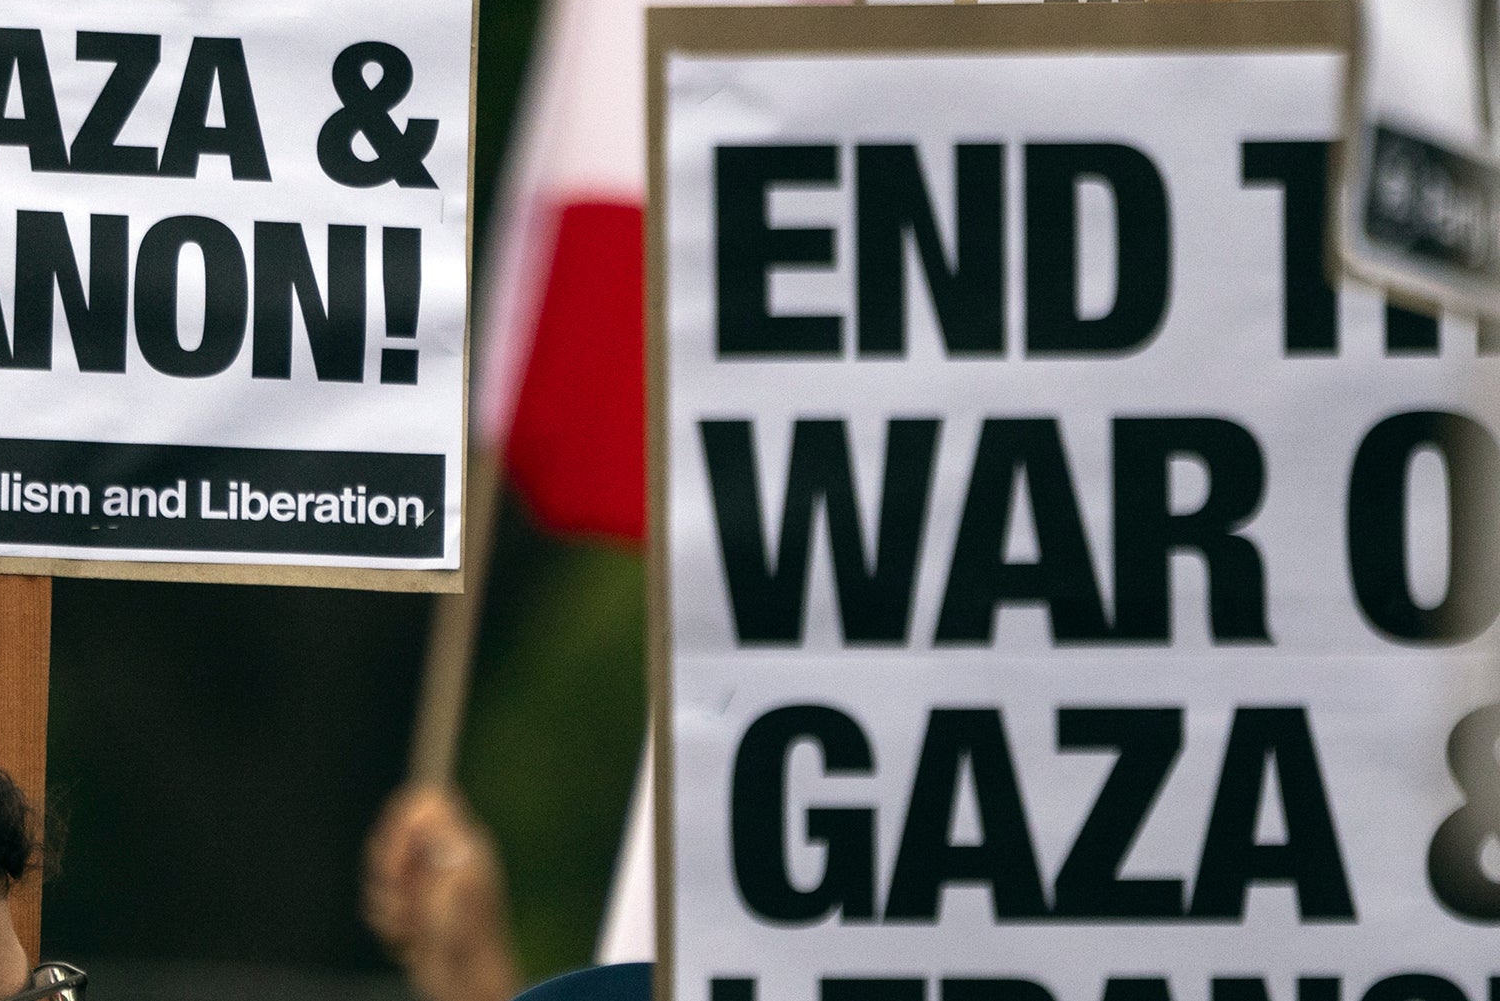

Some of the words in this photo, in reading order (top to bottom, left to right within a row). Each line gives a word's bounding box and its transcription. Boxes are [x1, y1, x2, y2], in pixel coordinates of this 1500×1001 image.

[316, 40, 441, 190] &
[711, 140, 1175, 363] END
[101, 479, 187, 519] and
[200, 480, 426, 527] Liberation
[696, 416, 1278, 648] WAR
[727, 701, 1361, 930] GAZA
